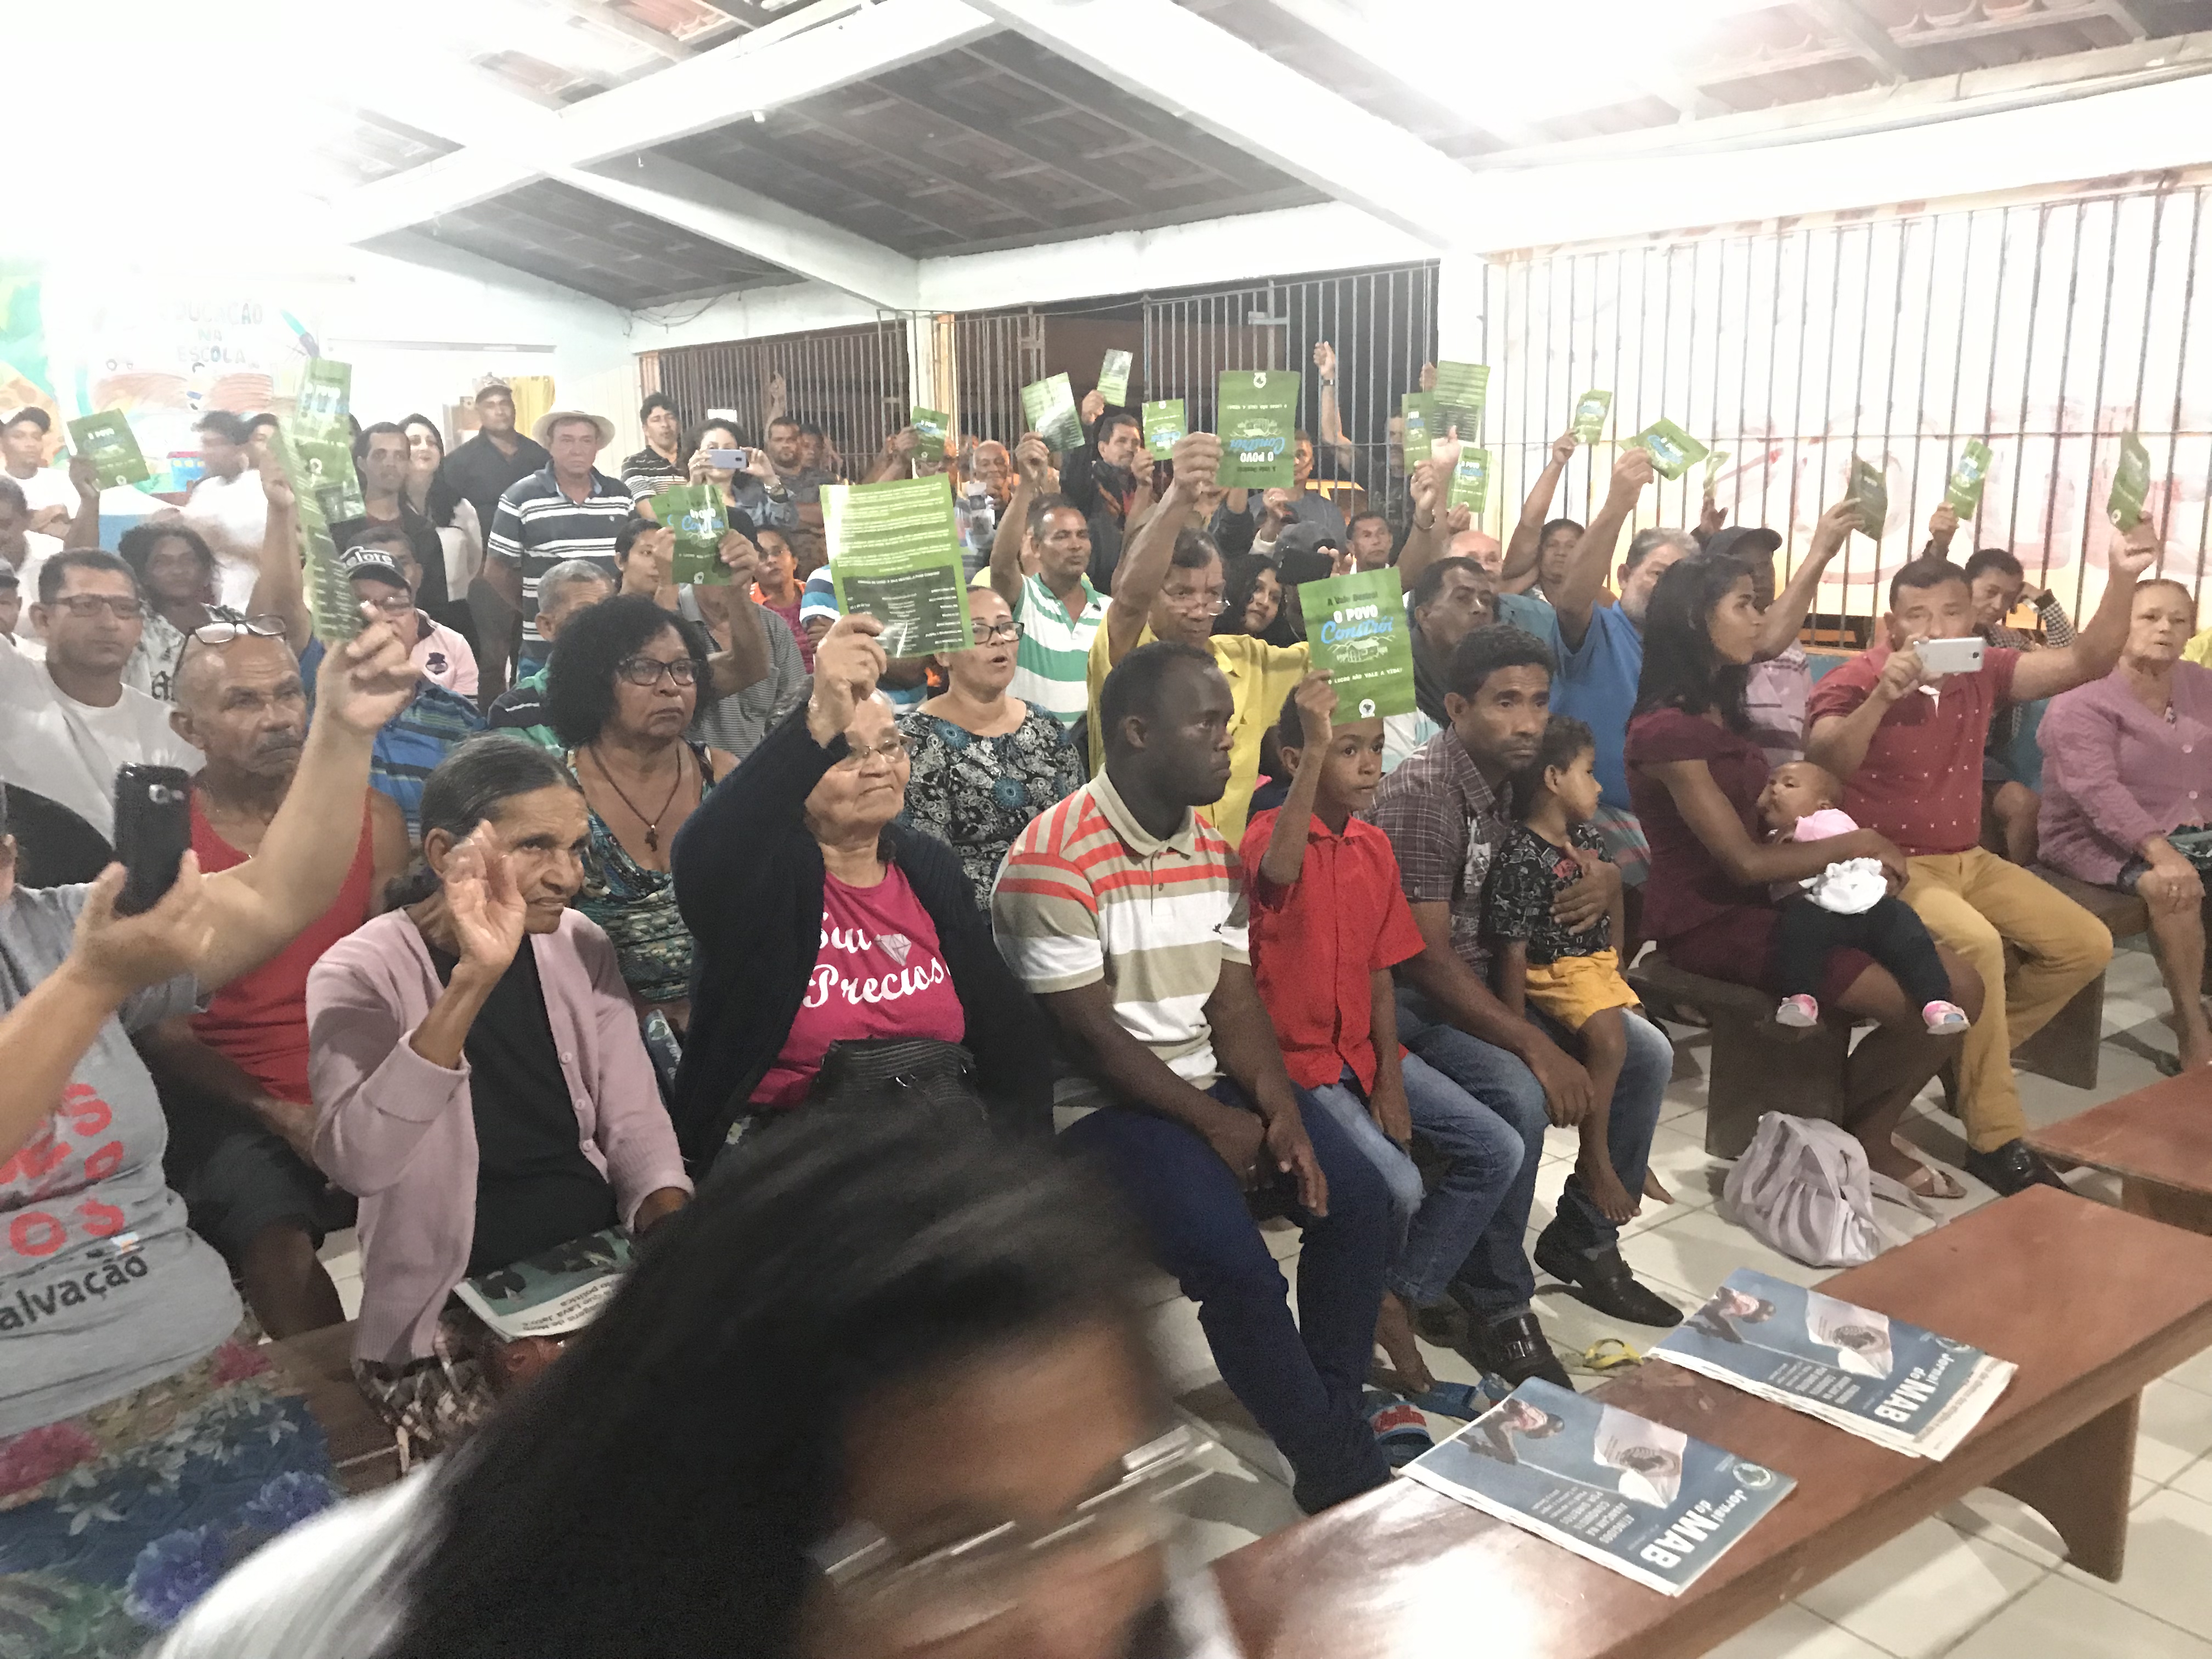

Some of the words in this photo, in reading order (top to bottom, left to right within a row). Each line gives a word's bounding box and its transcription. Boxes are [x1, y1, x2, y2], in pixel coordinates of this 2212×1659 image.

[198, 329, 222, 342] NA
[1240, 452, 1265, 462] POVO
[1267, 451, 1274, 462] O
[1333, 610, 1342, 623] O
[1346, 604, 1378, 622] POVO
[1321, 615, 1394, 644] Constrói
[802, 957, 951, 1008] Precios
[1910, 1366, 1926, 1380] do
[1925, 1352, 1955, 1386] Jornal
[1874, 1378, 1936, 1422] MAB
[1694, 1499, 1713, 1514] do
[1711, 1488, 1747, 1523] Jornal
[1640, 1509, 1720, 1568] MAB
